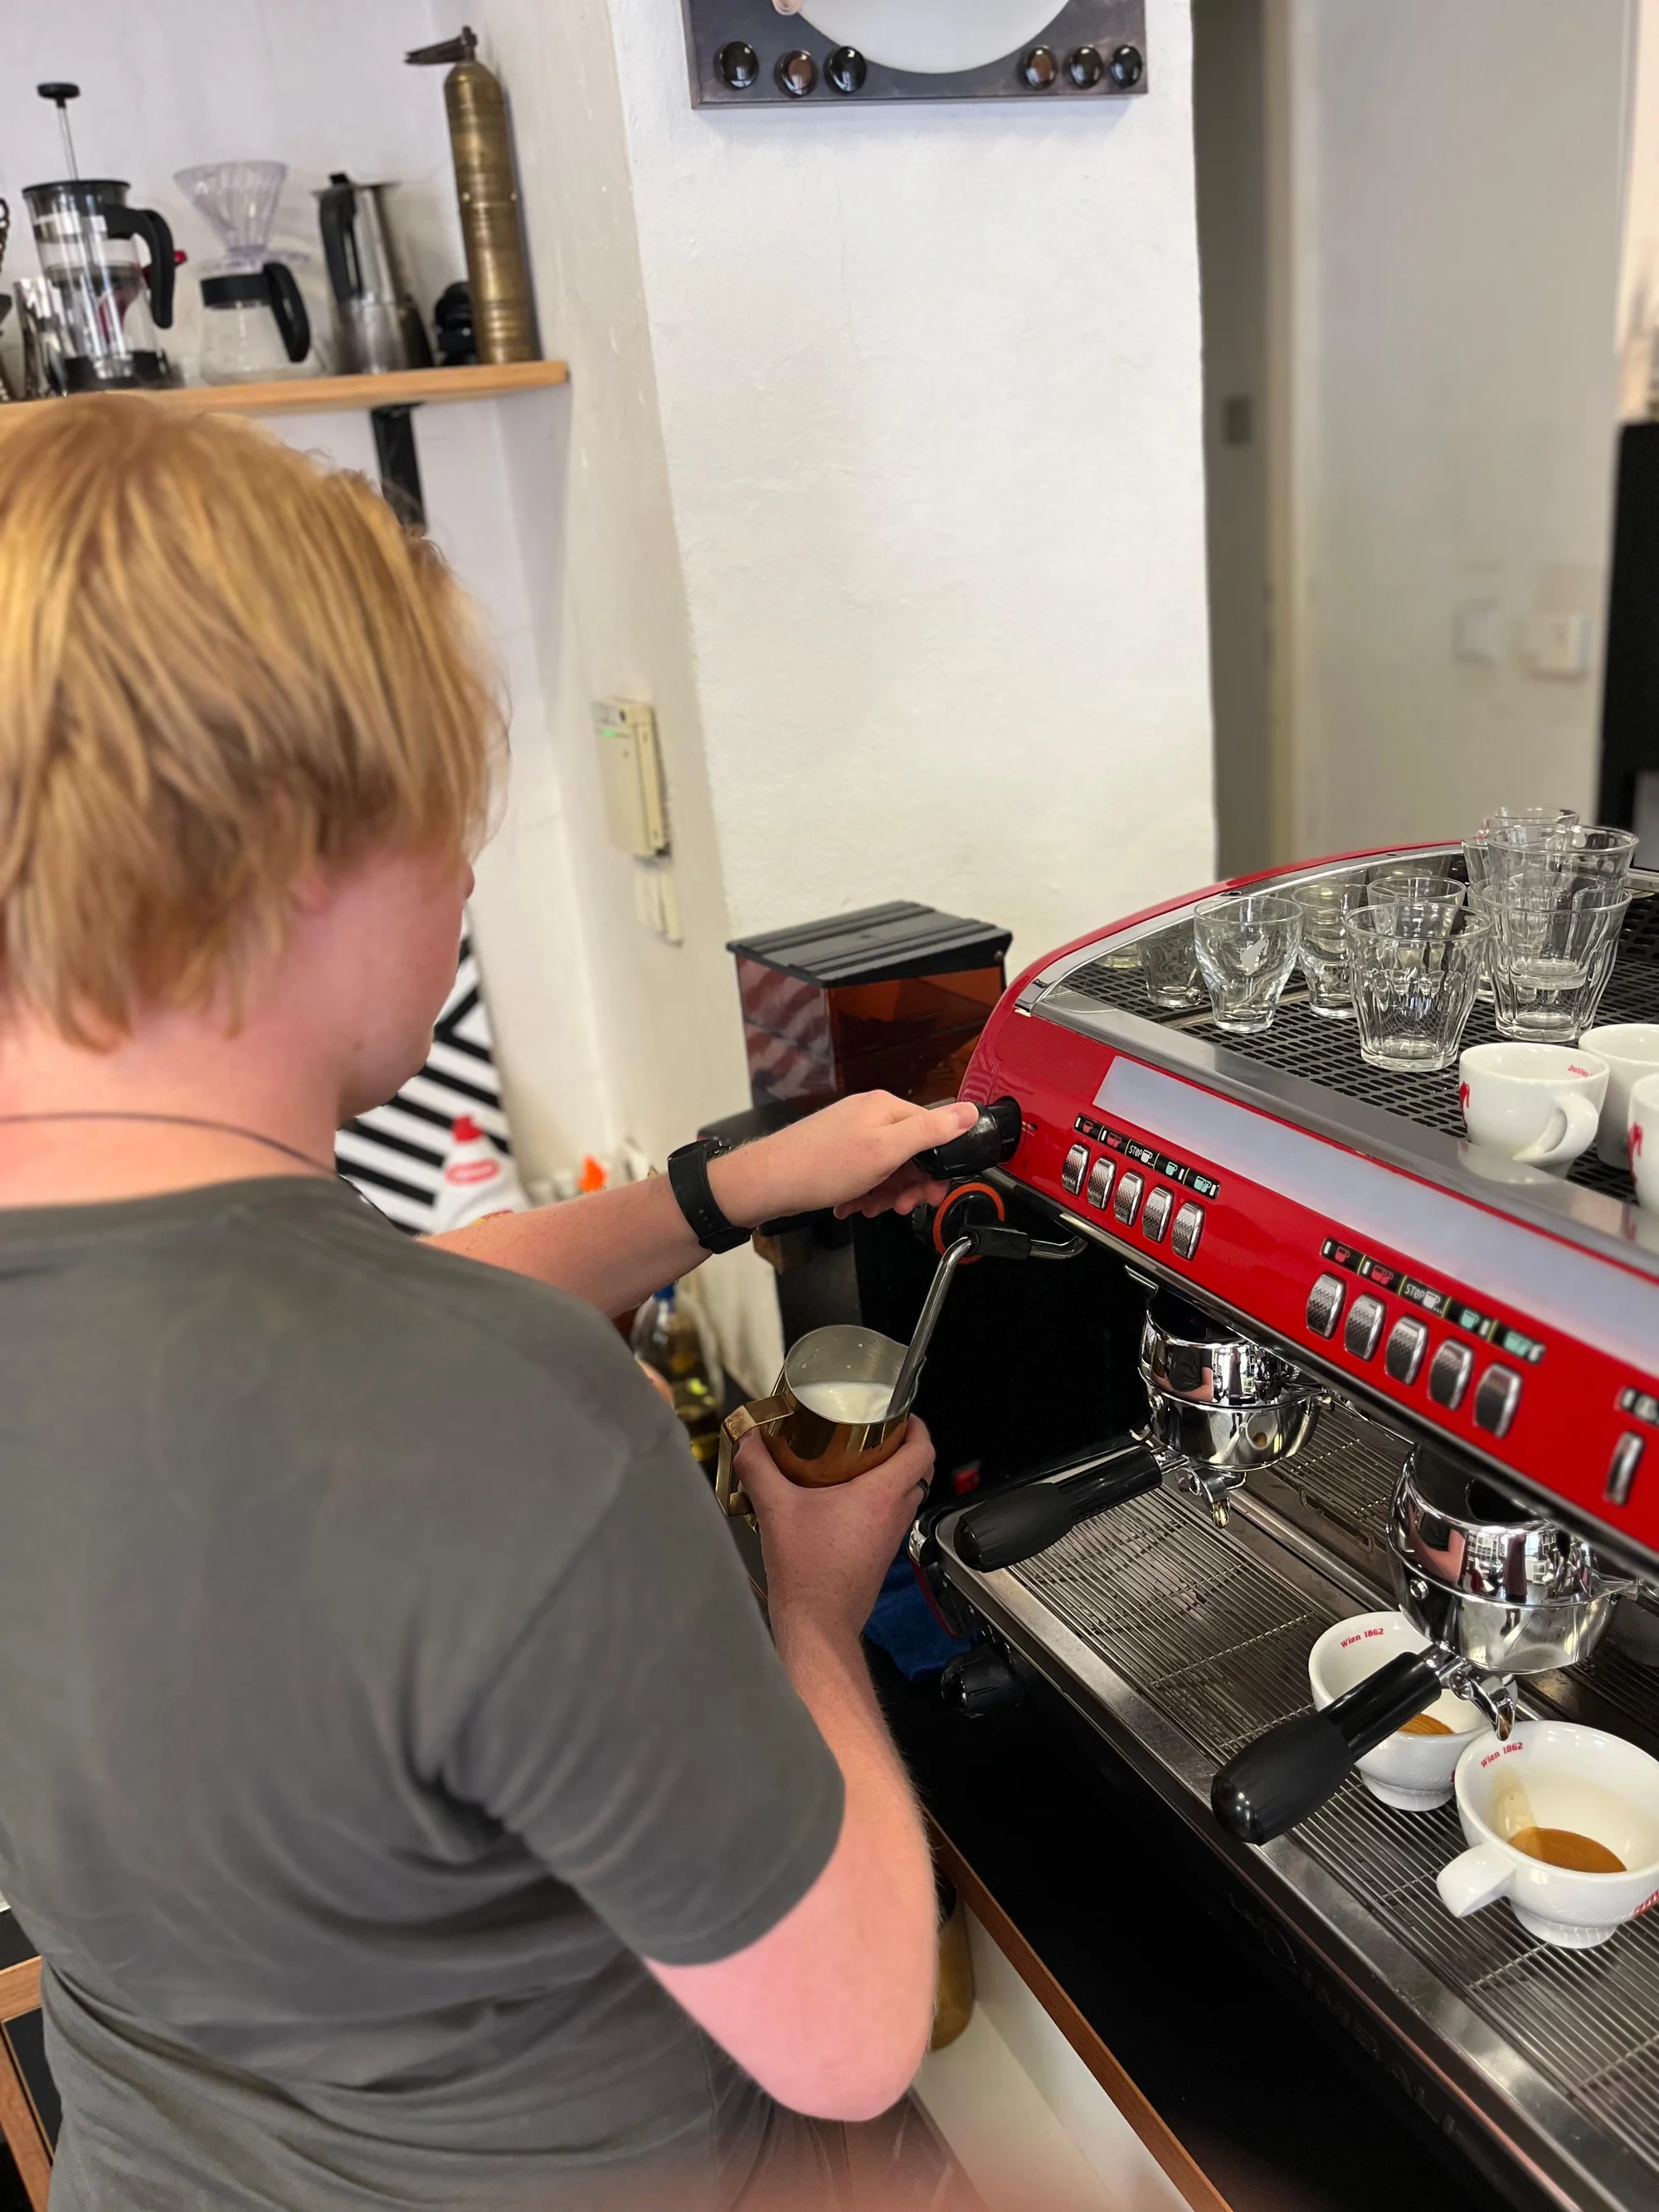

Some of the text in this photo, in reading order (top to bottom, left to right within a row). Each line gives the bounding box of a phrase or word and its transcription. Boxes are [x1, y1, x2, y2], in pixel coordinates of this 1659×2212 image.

[1128, 1145, 1143, 1158] STOP
[1404, 1283, 1425, 1300] STOP
[1340, 1627, 1384, 1648] Wien 1862
[1480, 1741, 1524, 1767] Wien 1862
